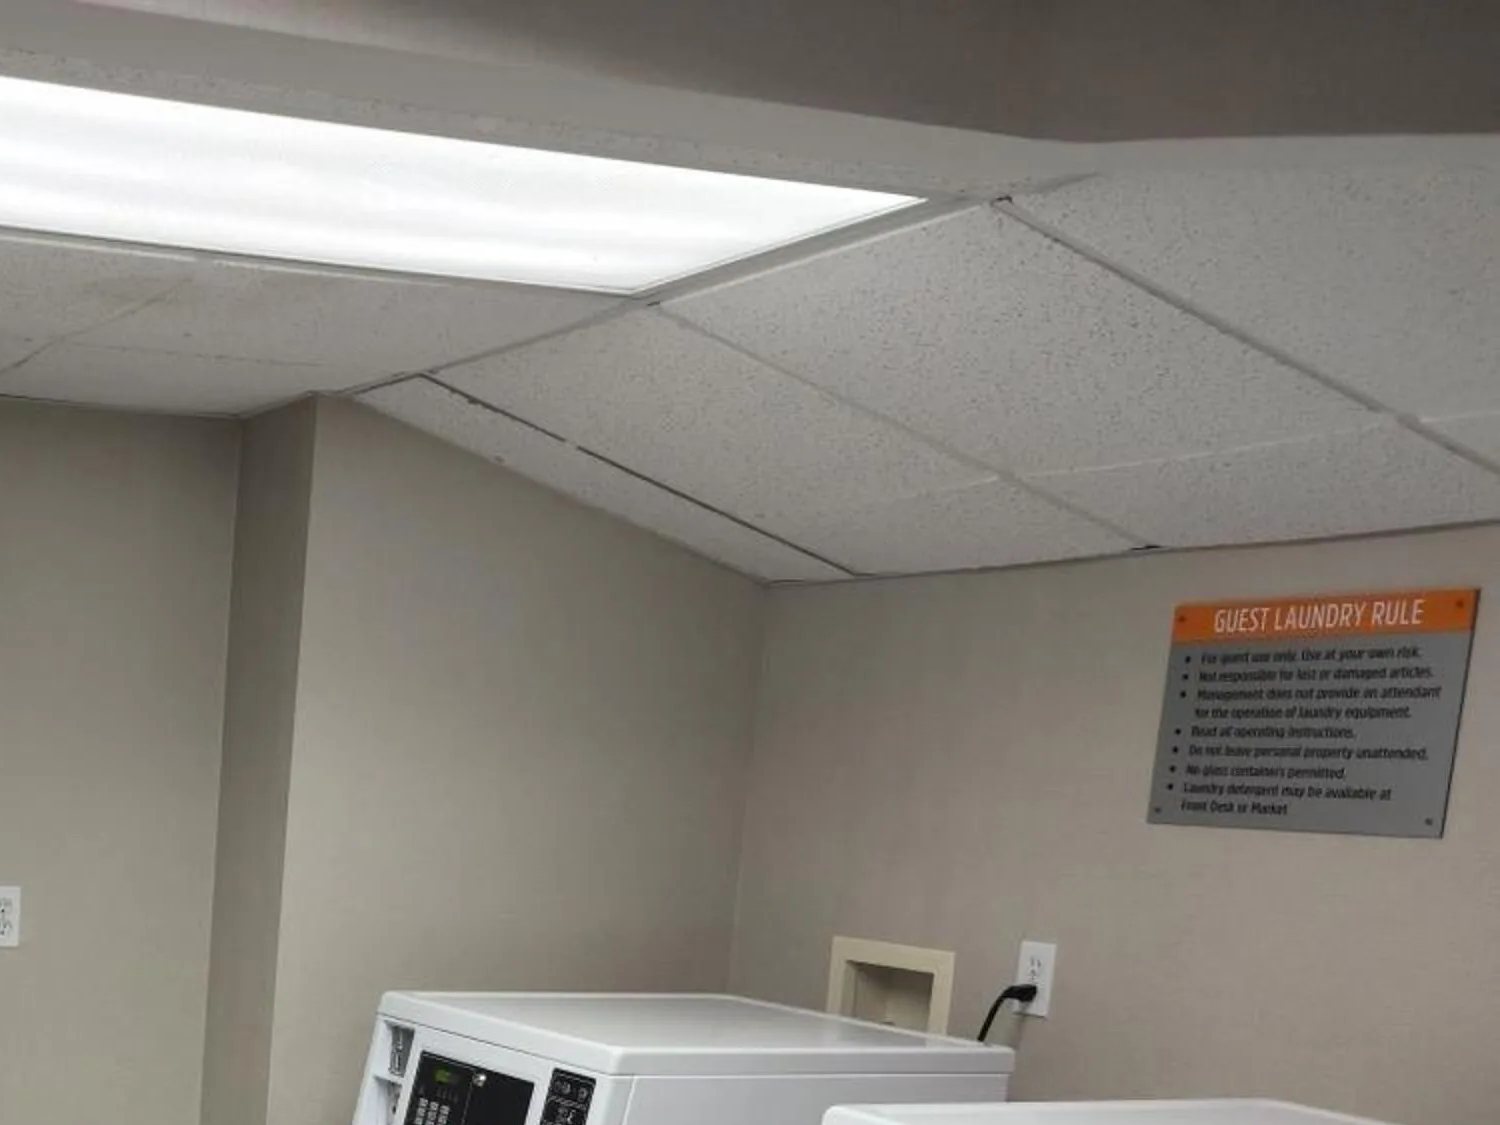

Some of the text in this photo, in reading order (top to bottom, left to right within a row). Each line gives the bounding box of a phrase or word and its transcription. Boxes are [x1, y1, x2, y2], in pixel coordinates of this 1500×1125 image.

[1214, 598, 1426, 633] GUEST LAUNDRY RULE
[1339, 649, 1363, 662] your
[1219, 670, 1277, 682] responsible
[1319, 671, 1332, 680] or
[1333, 668, 1387, 680] damaged
[1316, 687, 1361, 700] provide
[1381, 686, 1441, 699] attendant
[1211, 708, 1229, 718] the
[1230, 707, 1283, 720] operation
[1284, 705, 1298, 718] of
[1299, 706, 1343, 720] laundry
[1234, 726, 1286, 739] operating
[1189, 744, 1203, 756] Do
[1205, 746, 1222, 757] not
[1224, 746, 1253, 757] leave
[1253, 746, 1302, 759] personal
[1303, 747, 1354, 761] property
[1230, 766, 1286, 777] containers
[1183, 782, 1392, 801] Laundry detergent may be available at
[1209, 800, 1235, 813] Desk
[1237, 802, 1250, 814] or
[1250, 801, 1288, 815] Market
